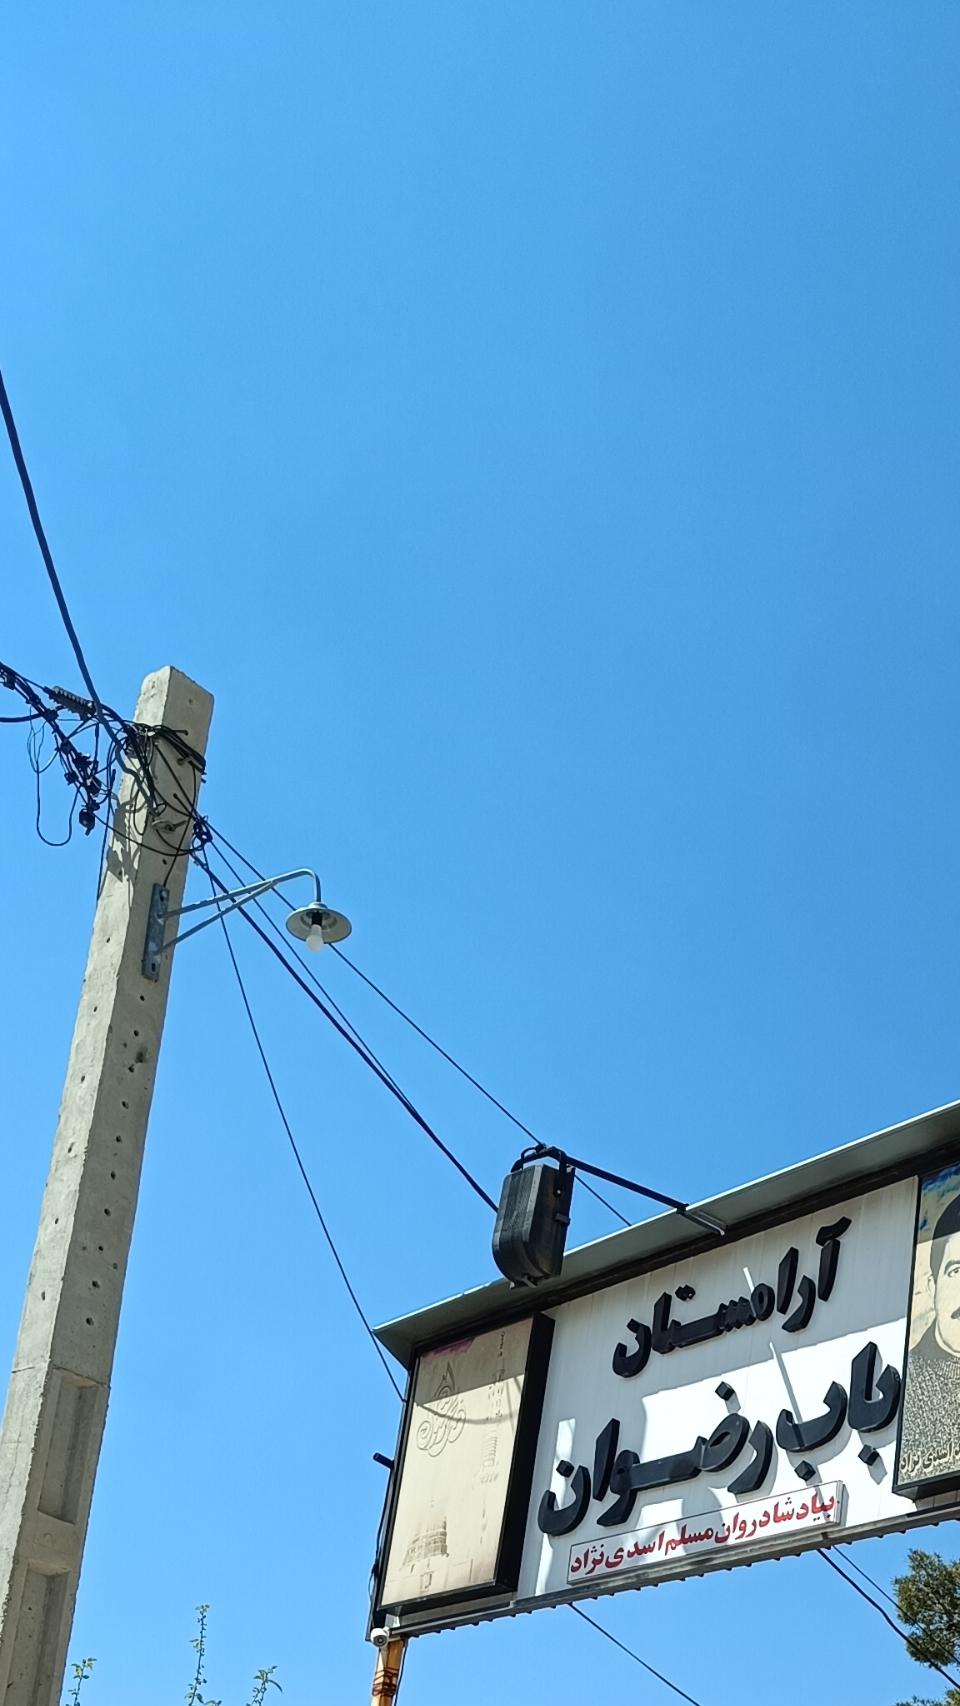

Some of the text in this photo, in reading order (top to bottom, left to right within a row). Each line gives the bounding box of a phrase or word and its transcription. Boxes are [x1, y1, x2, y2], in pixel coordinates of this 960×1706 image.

[612, 1216, 852, 1378] آرامستان
[538, 1381, 774, 1536] رضوان
[776, 1341, 902, 1481] باب
[604, 1530, 664, 1569] اسدی
[665, 1524, 713, 1556] مسلم
